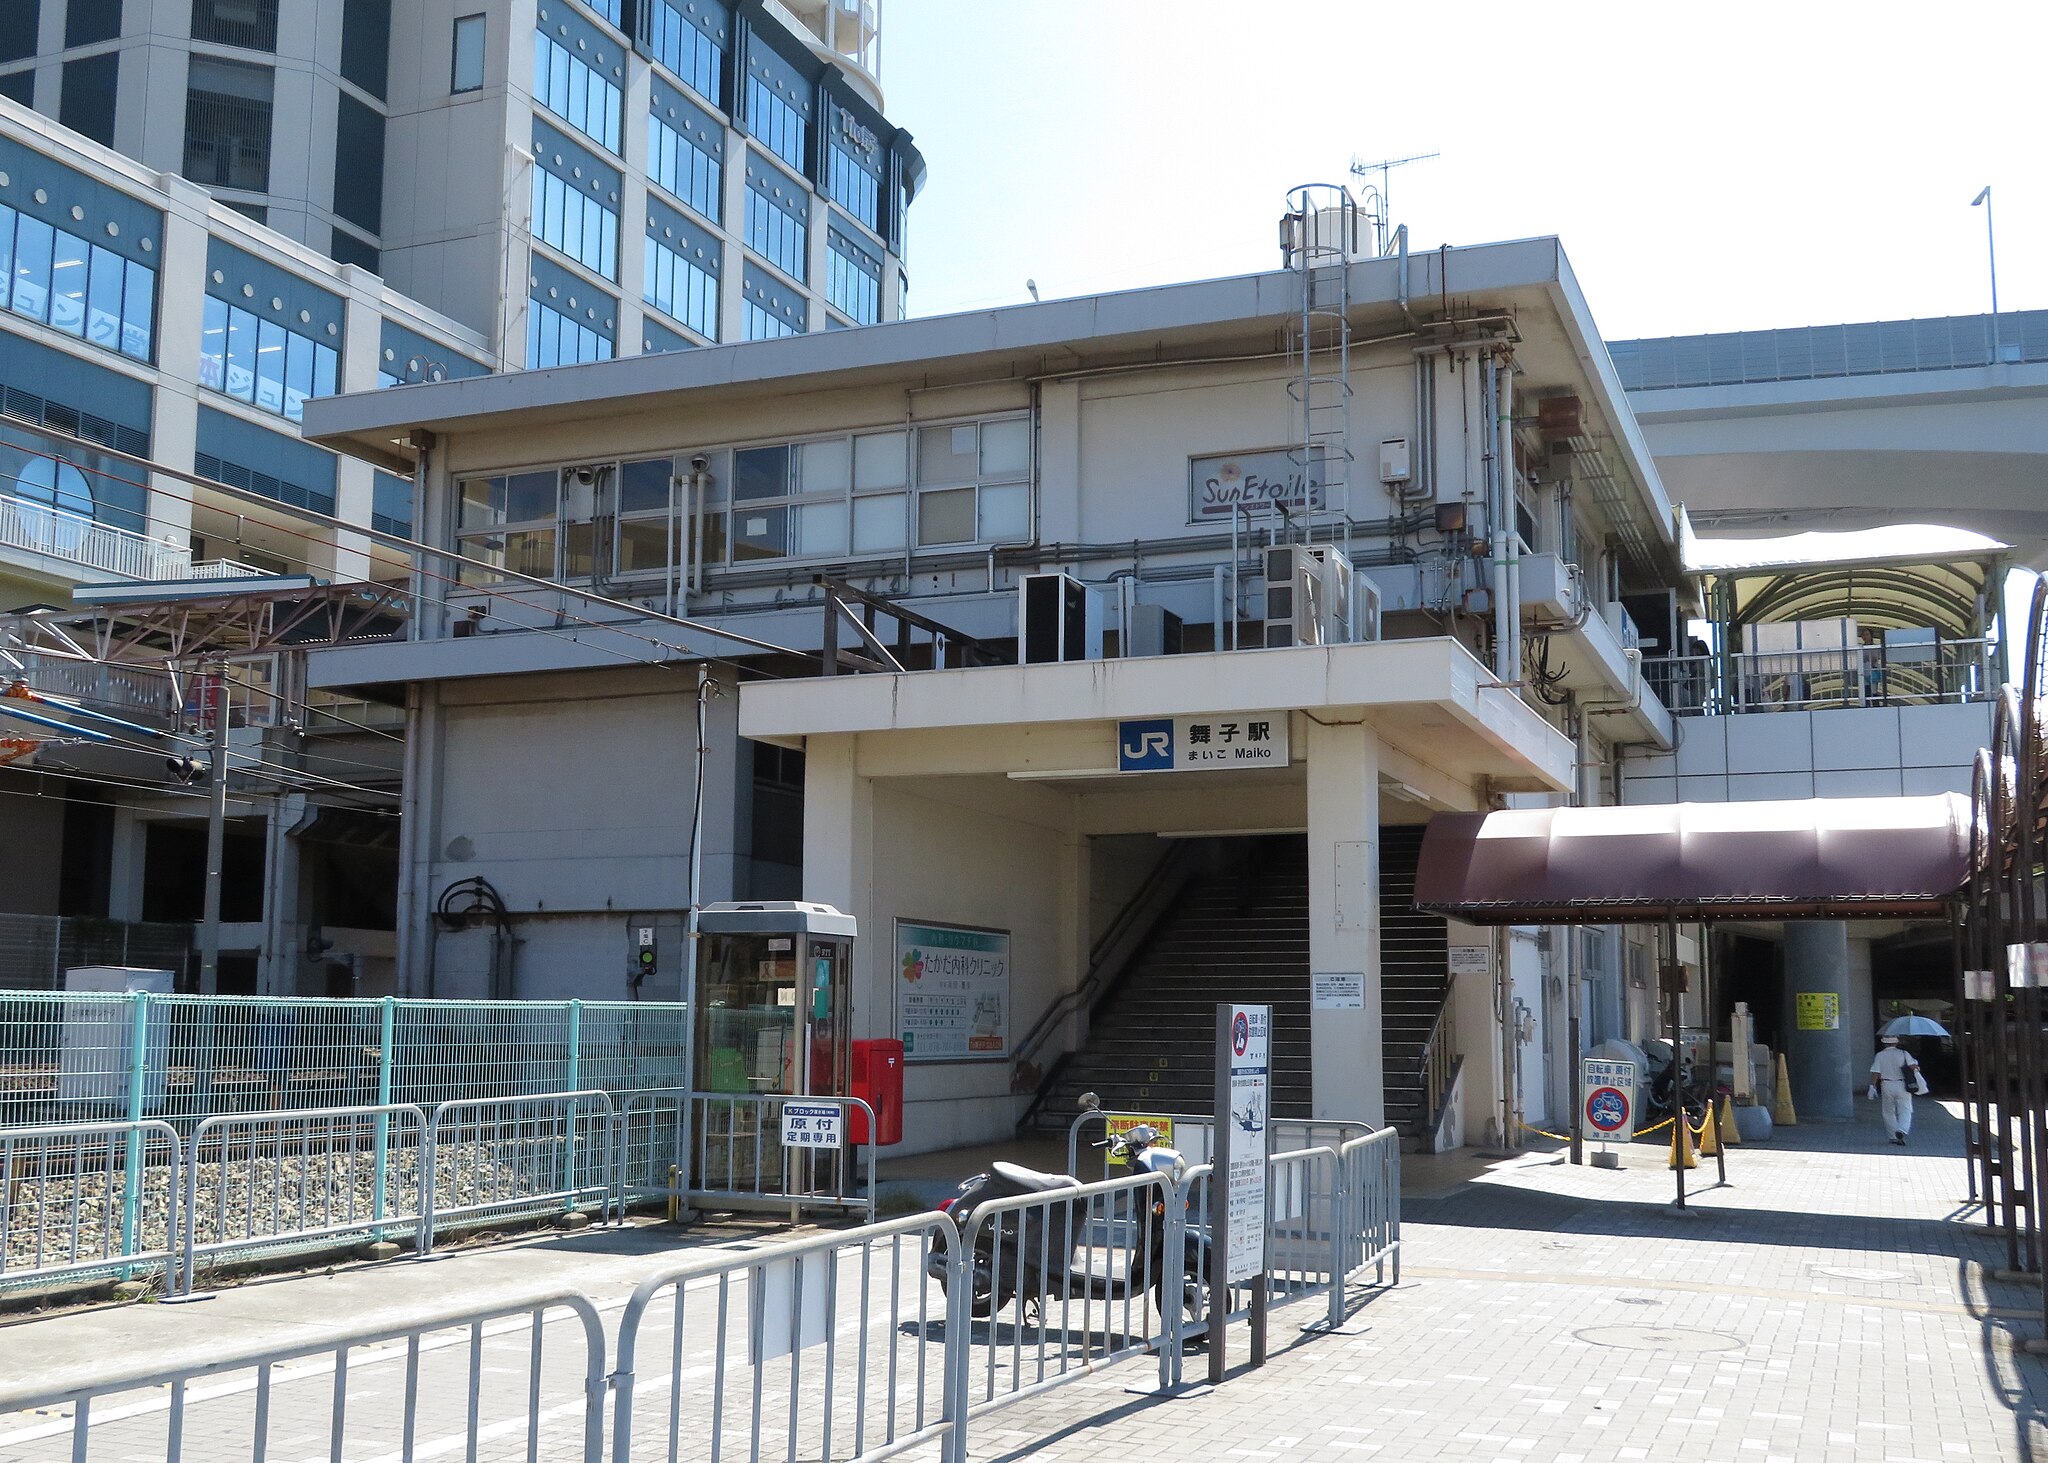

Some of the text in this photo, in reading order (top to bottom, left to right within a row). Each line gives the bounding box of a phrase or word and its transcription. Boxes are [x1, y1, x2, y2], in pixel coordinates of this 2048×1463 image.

[1189, 721, 1271, 745] 舞子駅
[1124, 732, 1170, 759] JR
[1188, 747, 1271, 761] まいこ Maiko
[924, 953, 1004, 978] たかだ内科クリニック
[790, 1117, 833, 1130] 原付
[787, 1131, 836, 1144] 定期専用
